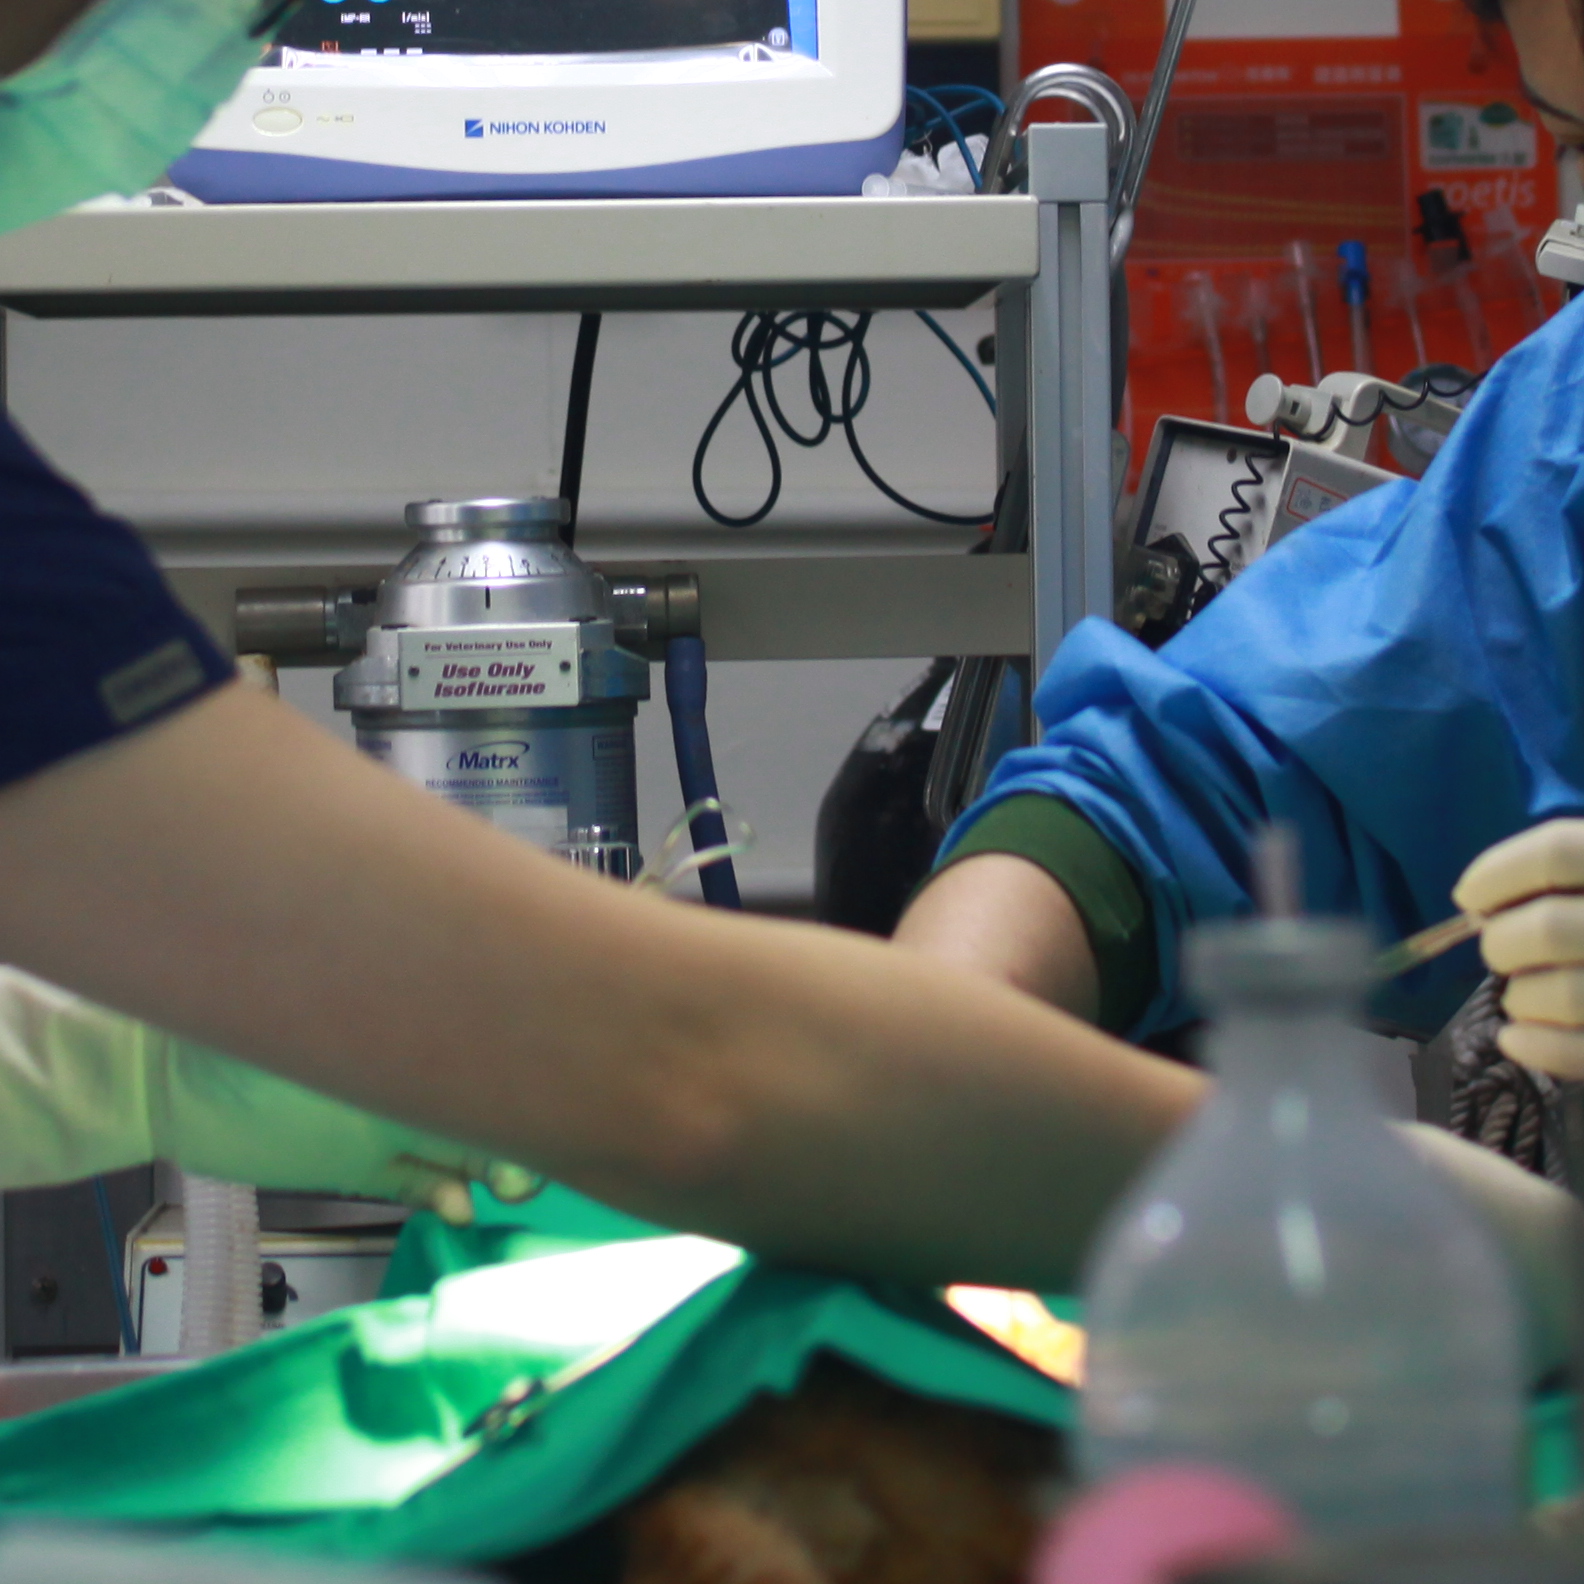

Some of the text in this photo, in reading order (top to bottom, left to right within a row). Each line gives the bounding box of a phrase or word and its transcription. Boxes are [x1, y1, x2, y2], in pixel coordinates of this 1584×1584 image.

[490, 120, 606, 134] NIHON KOHDEN
[424, 640, 552, 652] For Veterinary Use Only
[442, 662, 535, 680] Use Only
[434, 682, 546, 699] Isoflurane
[458, 752, 519, 770] Matrx
